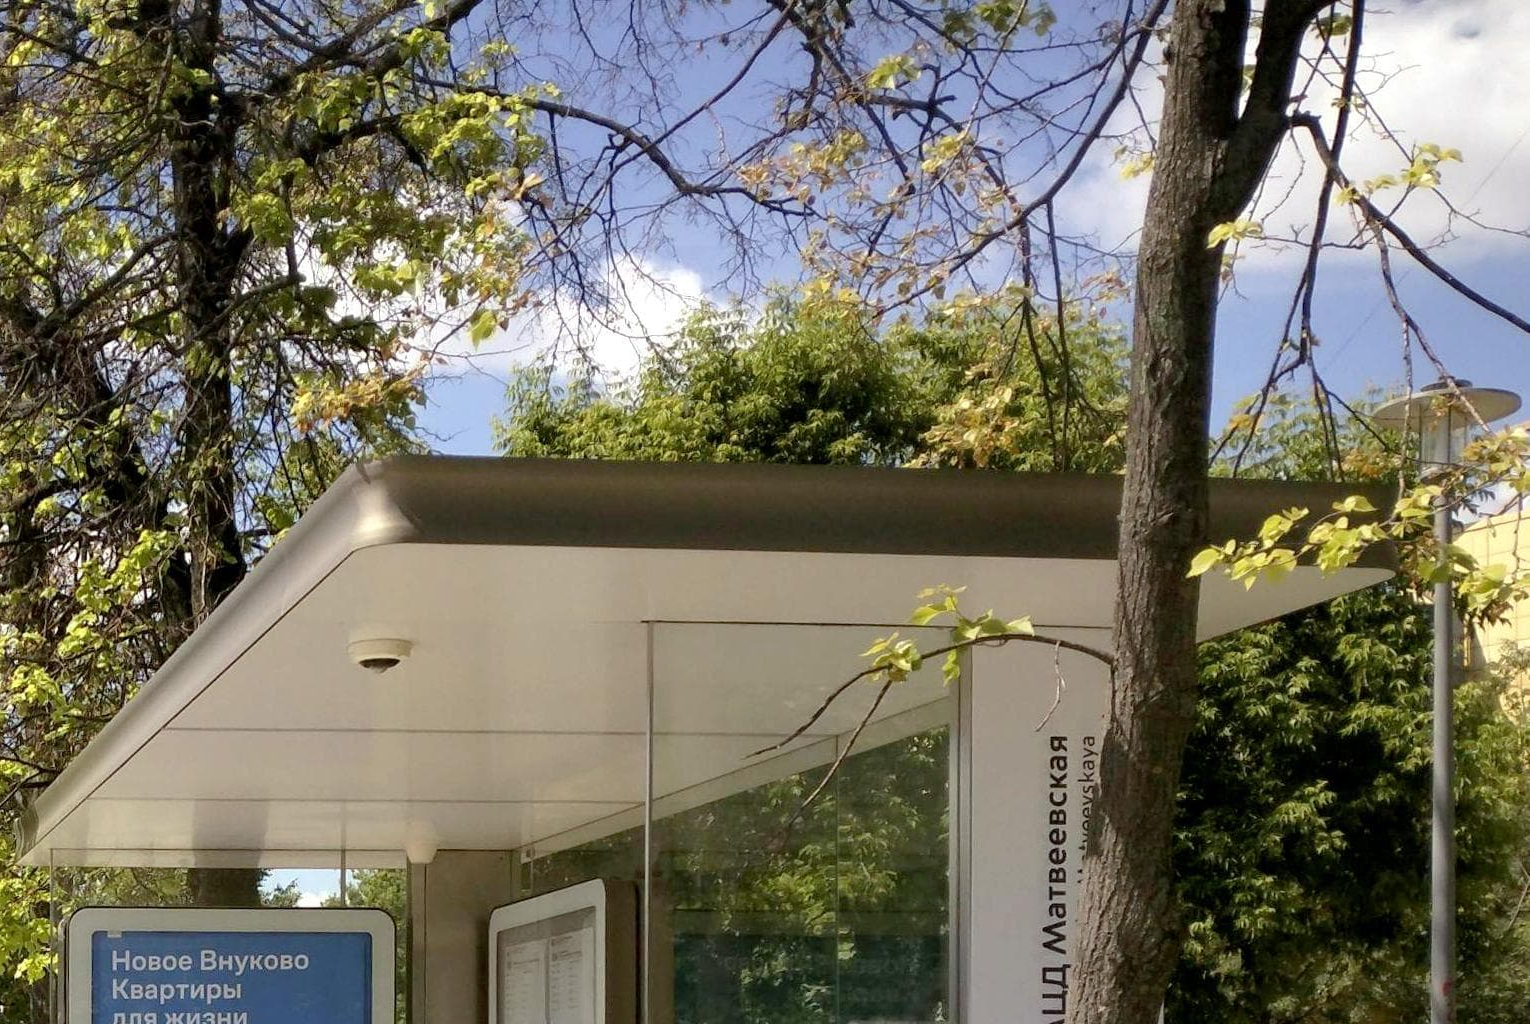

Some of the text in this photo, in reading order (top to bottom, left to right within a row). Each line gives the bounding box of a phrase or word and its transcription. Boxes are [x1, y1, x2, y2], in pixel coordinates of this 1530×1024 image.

[1041, 735, 1069, 955] Матвеевская
[111, 949, 310, 976] Новое Внуково
[111, 978, 242, 1005] Квартиры
